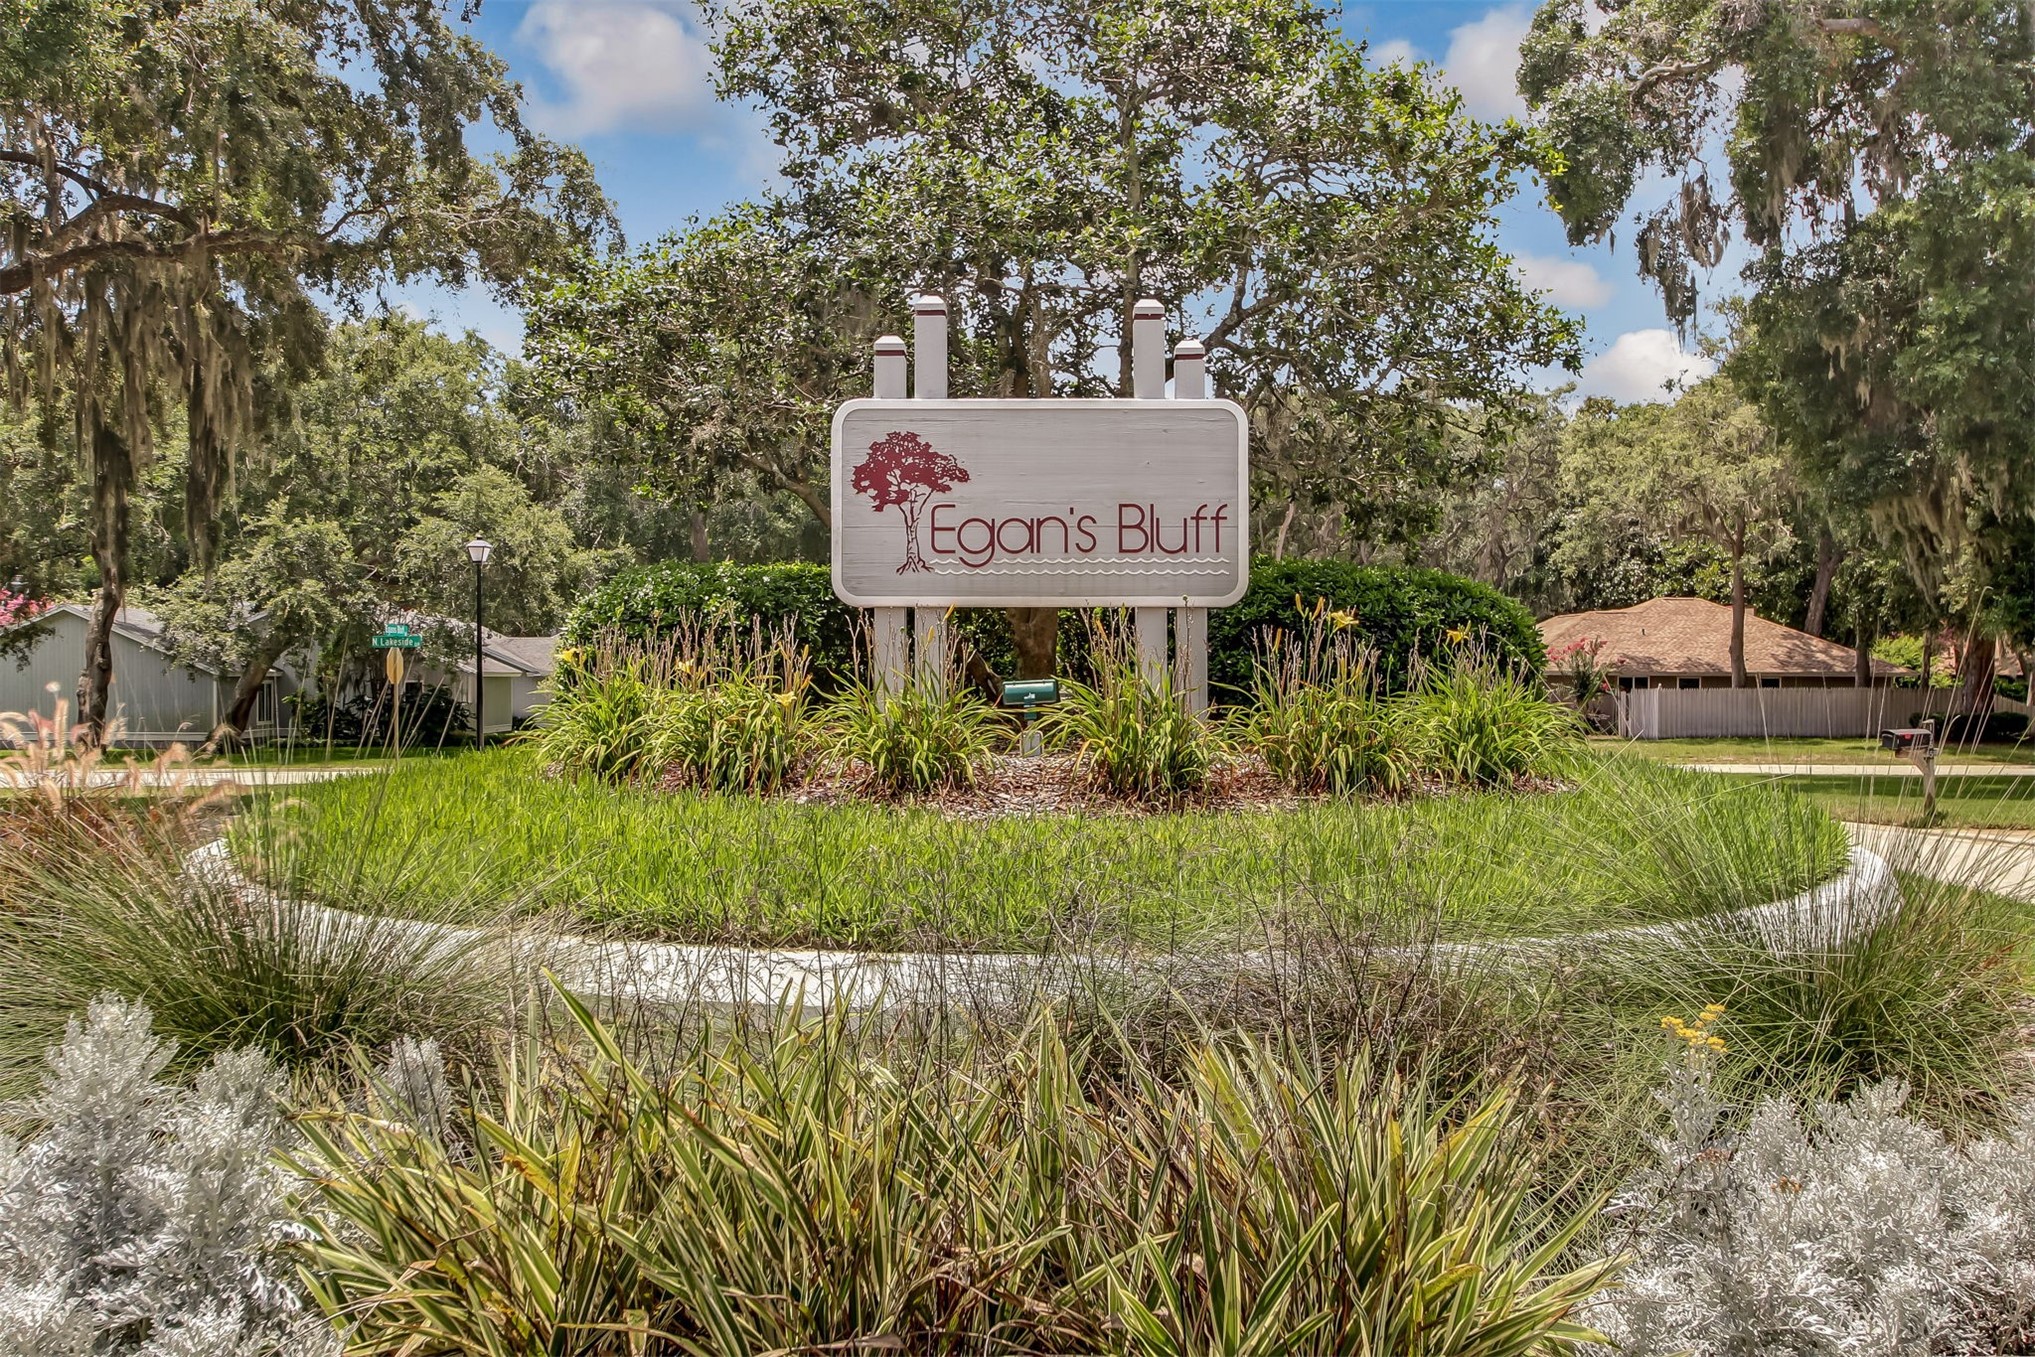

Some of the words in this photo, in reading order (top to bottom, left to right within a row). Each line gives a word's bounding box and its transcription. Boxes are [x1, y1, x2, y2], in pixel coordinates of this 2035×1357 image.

[930, 503, 1098, 568] Egan's
[1117, 503, 1228, 554] Bluff
[372, 637, 378, 646] N
[380, 637, 414, 646] Lakeside
